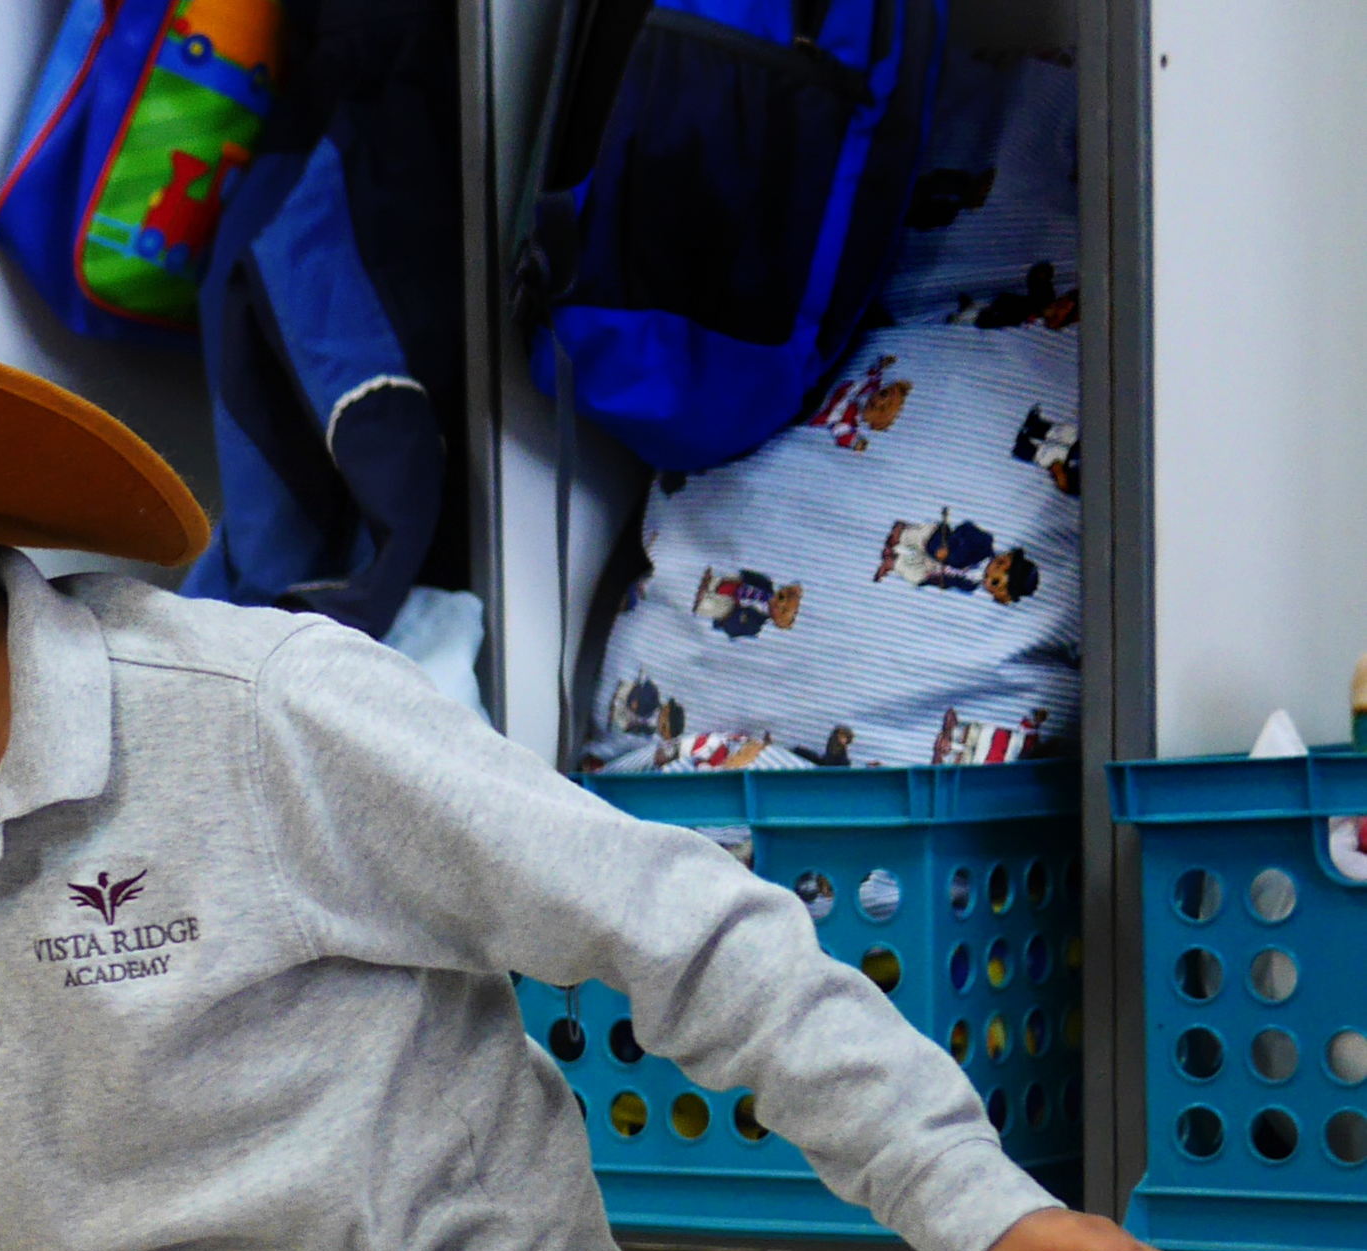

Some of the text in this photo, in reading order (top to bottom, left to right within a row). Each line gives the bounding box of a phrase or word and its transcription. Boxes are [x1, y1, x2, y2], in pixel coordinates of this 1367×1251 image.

[34, 916, 201, 962] VISTA RIDGE
[64, 954, 171, 988] ACADEMY
